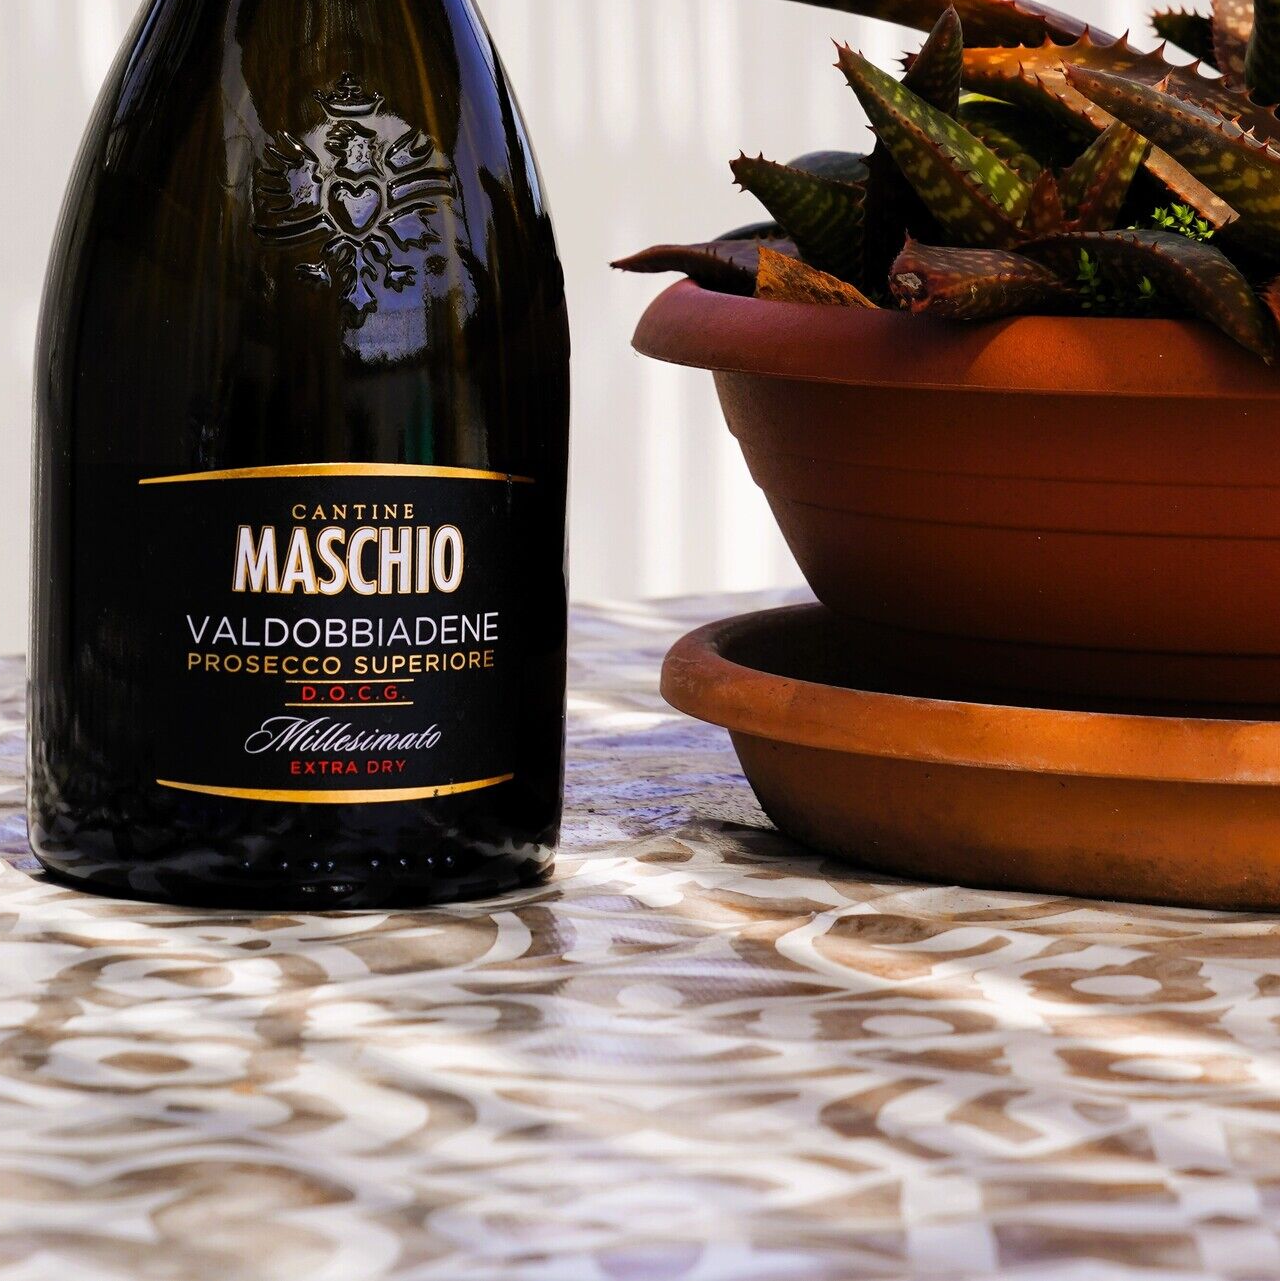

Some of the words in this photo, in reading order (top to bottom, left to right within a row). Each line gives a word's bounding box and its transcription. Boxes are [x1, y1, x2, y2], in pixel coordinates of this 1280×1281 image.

[292, 503, 414, 520] CANTINE
[231, 524, 464, 595] MASCHIO
[186, 612, 499, 648] VALDOBBIADENE
[187, 653, 341, 675] PROSECCO
[354, 650, 495, 674] SUPERIORE
[244, 716, 442, 754] Millesimato
[290, 760, 358, 775] EXTRA
[367, 759, 407, 774] DRY
